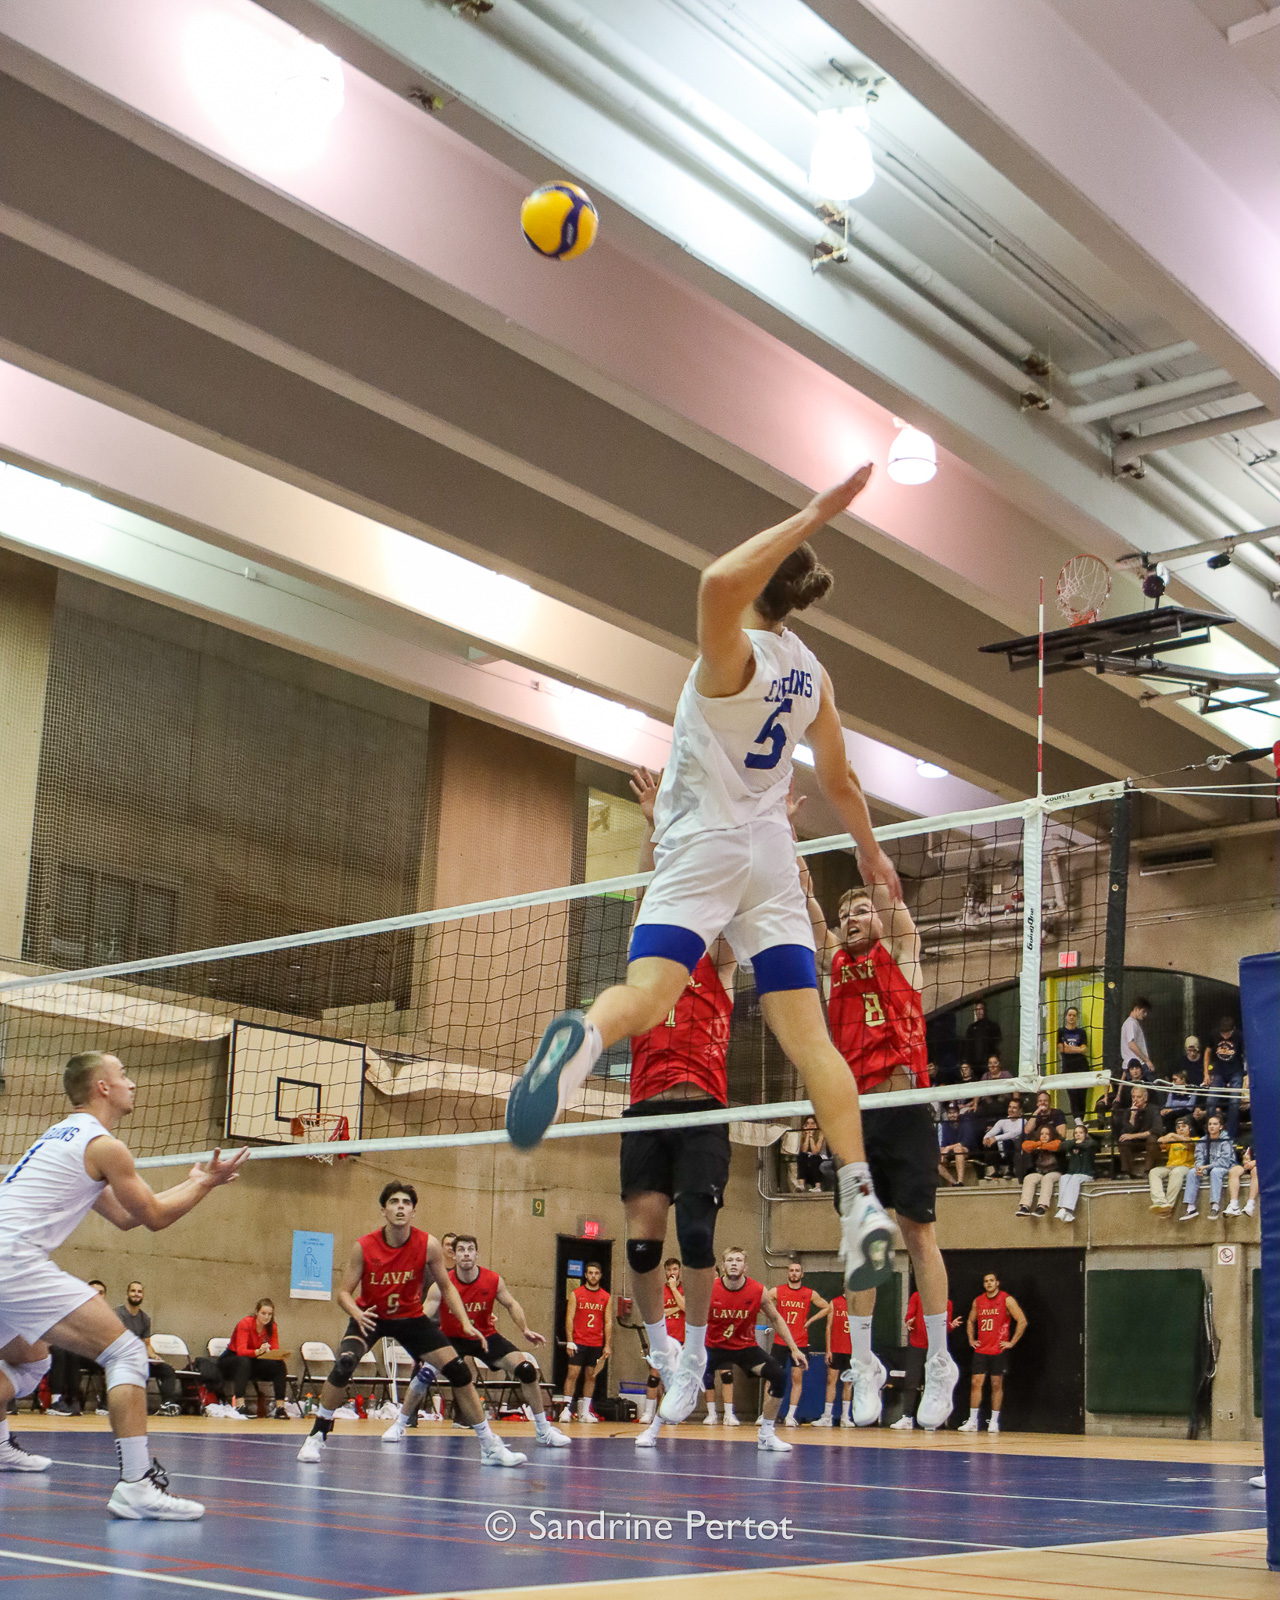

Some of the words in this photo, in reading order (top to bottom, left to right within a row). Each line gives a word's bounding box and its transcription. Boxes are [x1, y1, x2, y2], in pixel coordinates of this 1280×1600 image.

[744, 698, 793, 769] 5
[862, 992, 885, 1027] 8
[535, 1200, 543, 1214] 9
[370, 1269, 416, 1285] LAVAL
[579, 1301, 604, 1312] LAVAL
[781, 1300, 805, 1309] LAVAL
[587, 1313, 595, 1328] 2
[713, 1309, 749, 1319] LAVAL
[786, 1311, 798, 1325] 17
[981, 1318, 993, 1332] 20
